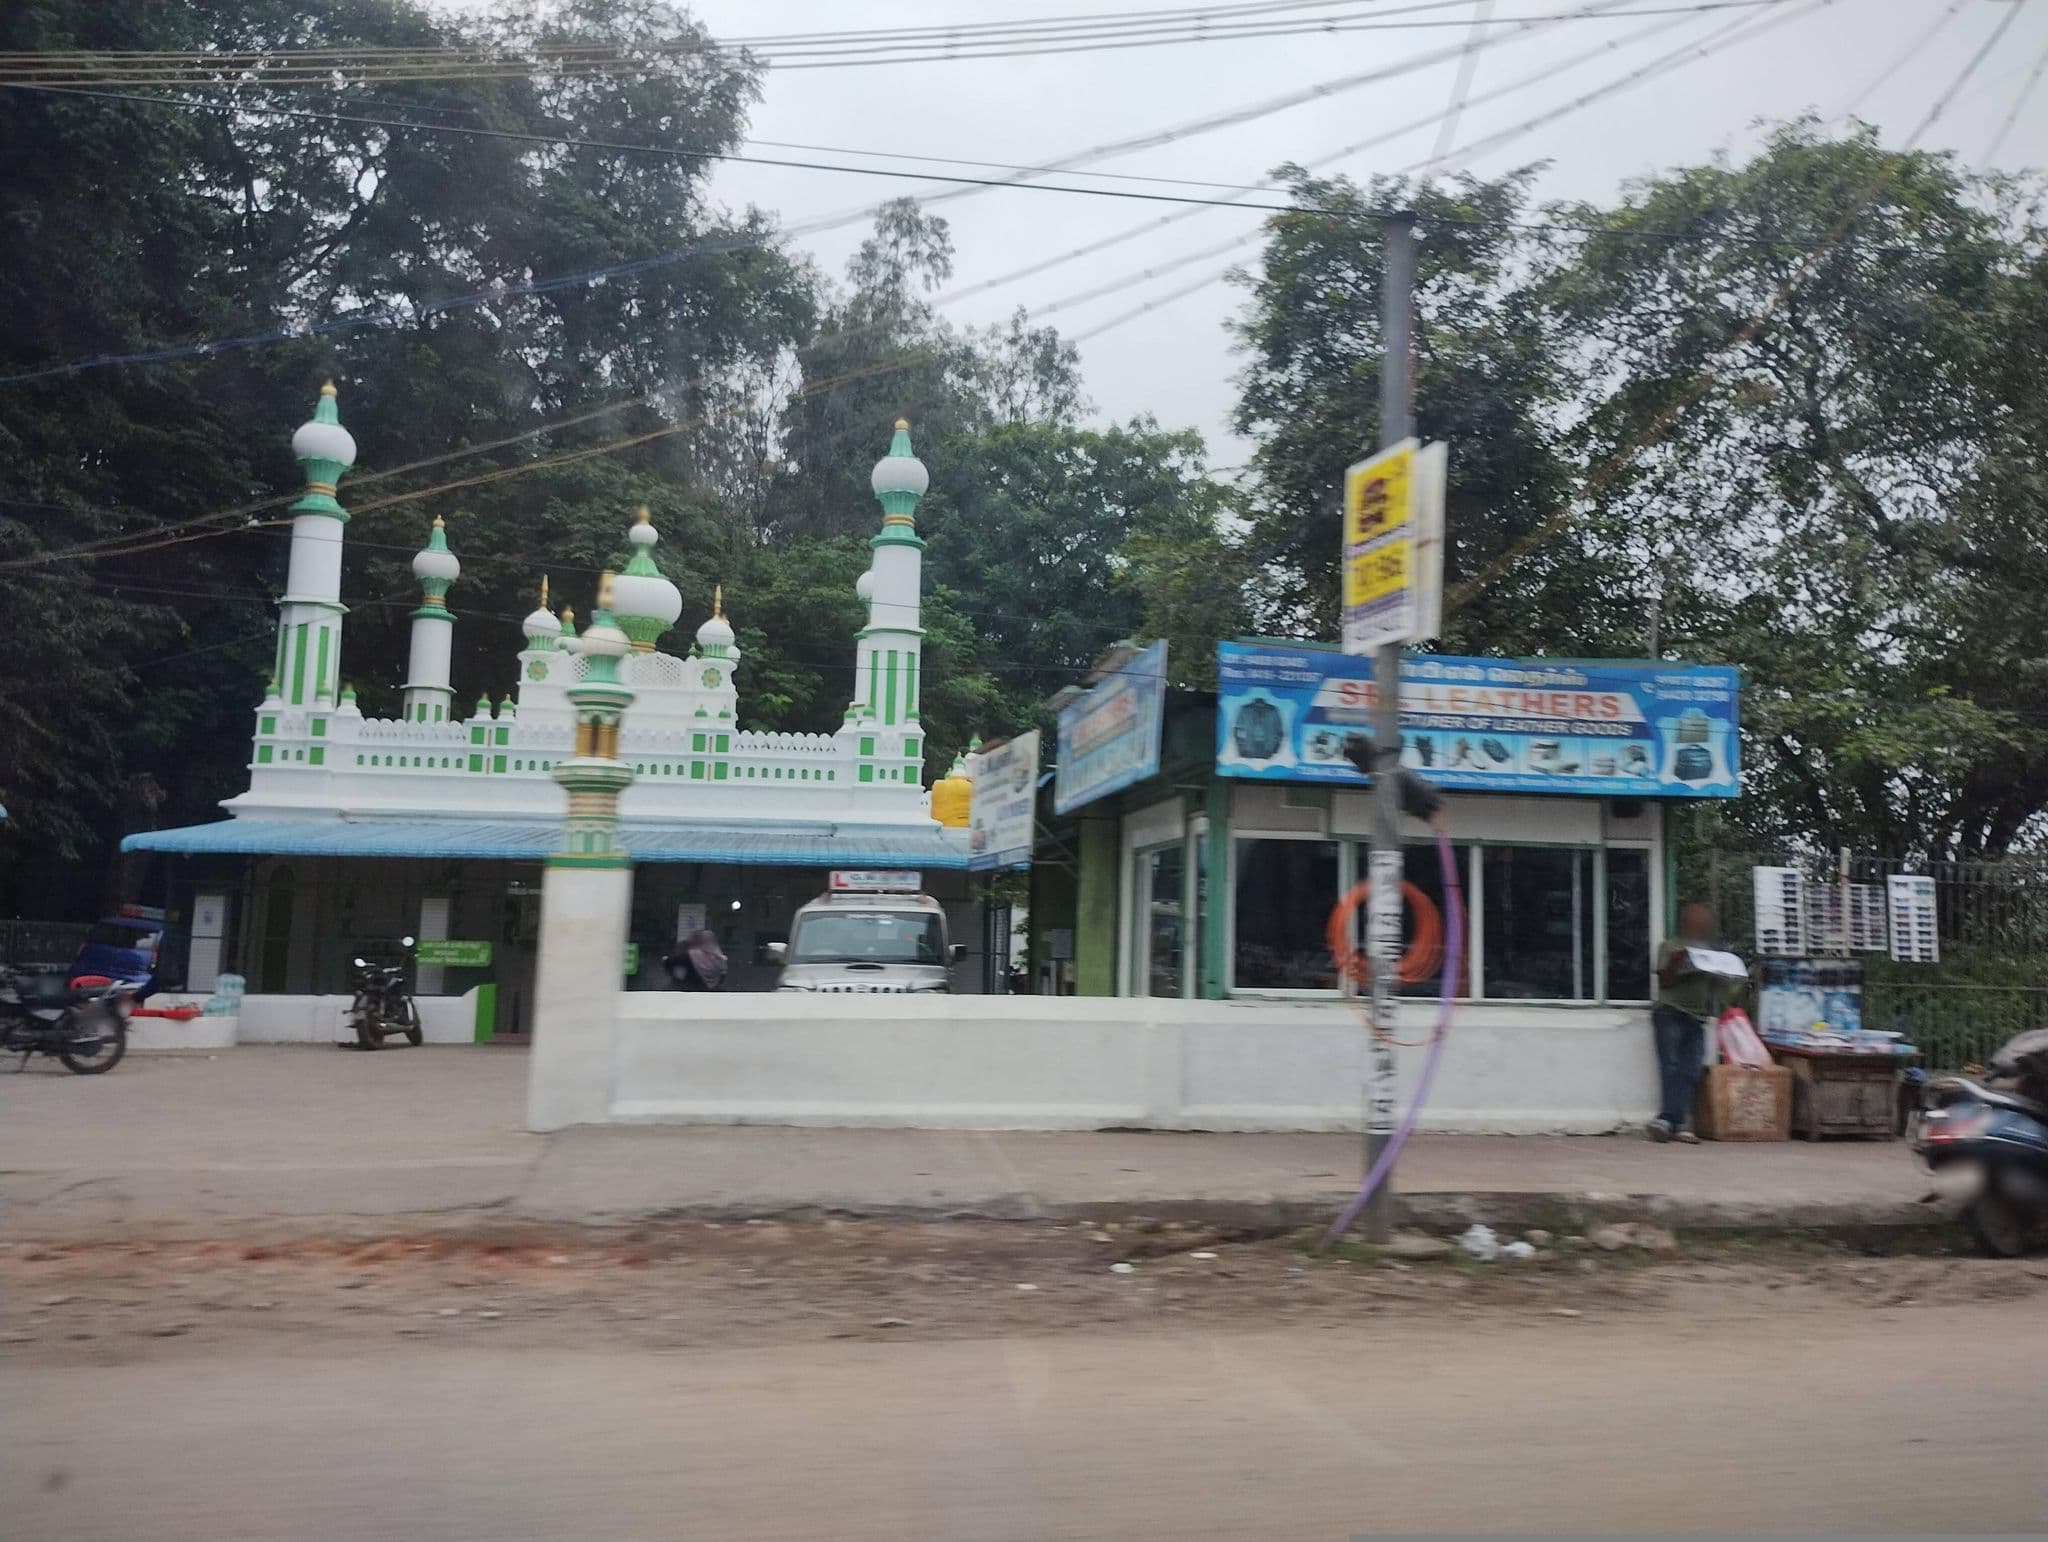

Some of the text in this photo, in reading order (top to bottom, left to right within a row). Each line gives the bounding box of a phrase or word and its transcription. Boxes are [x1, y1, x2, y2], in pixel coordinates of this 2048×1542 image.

[1424, 685, 1622, 718] LEATHERS
[1467, 717, 1492, 730] OF
[1492, 718, 1569, 734] LEATHER
[1569, 721, 1633, 737] GOODS
